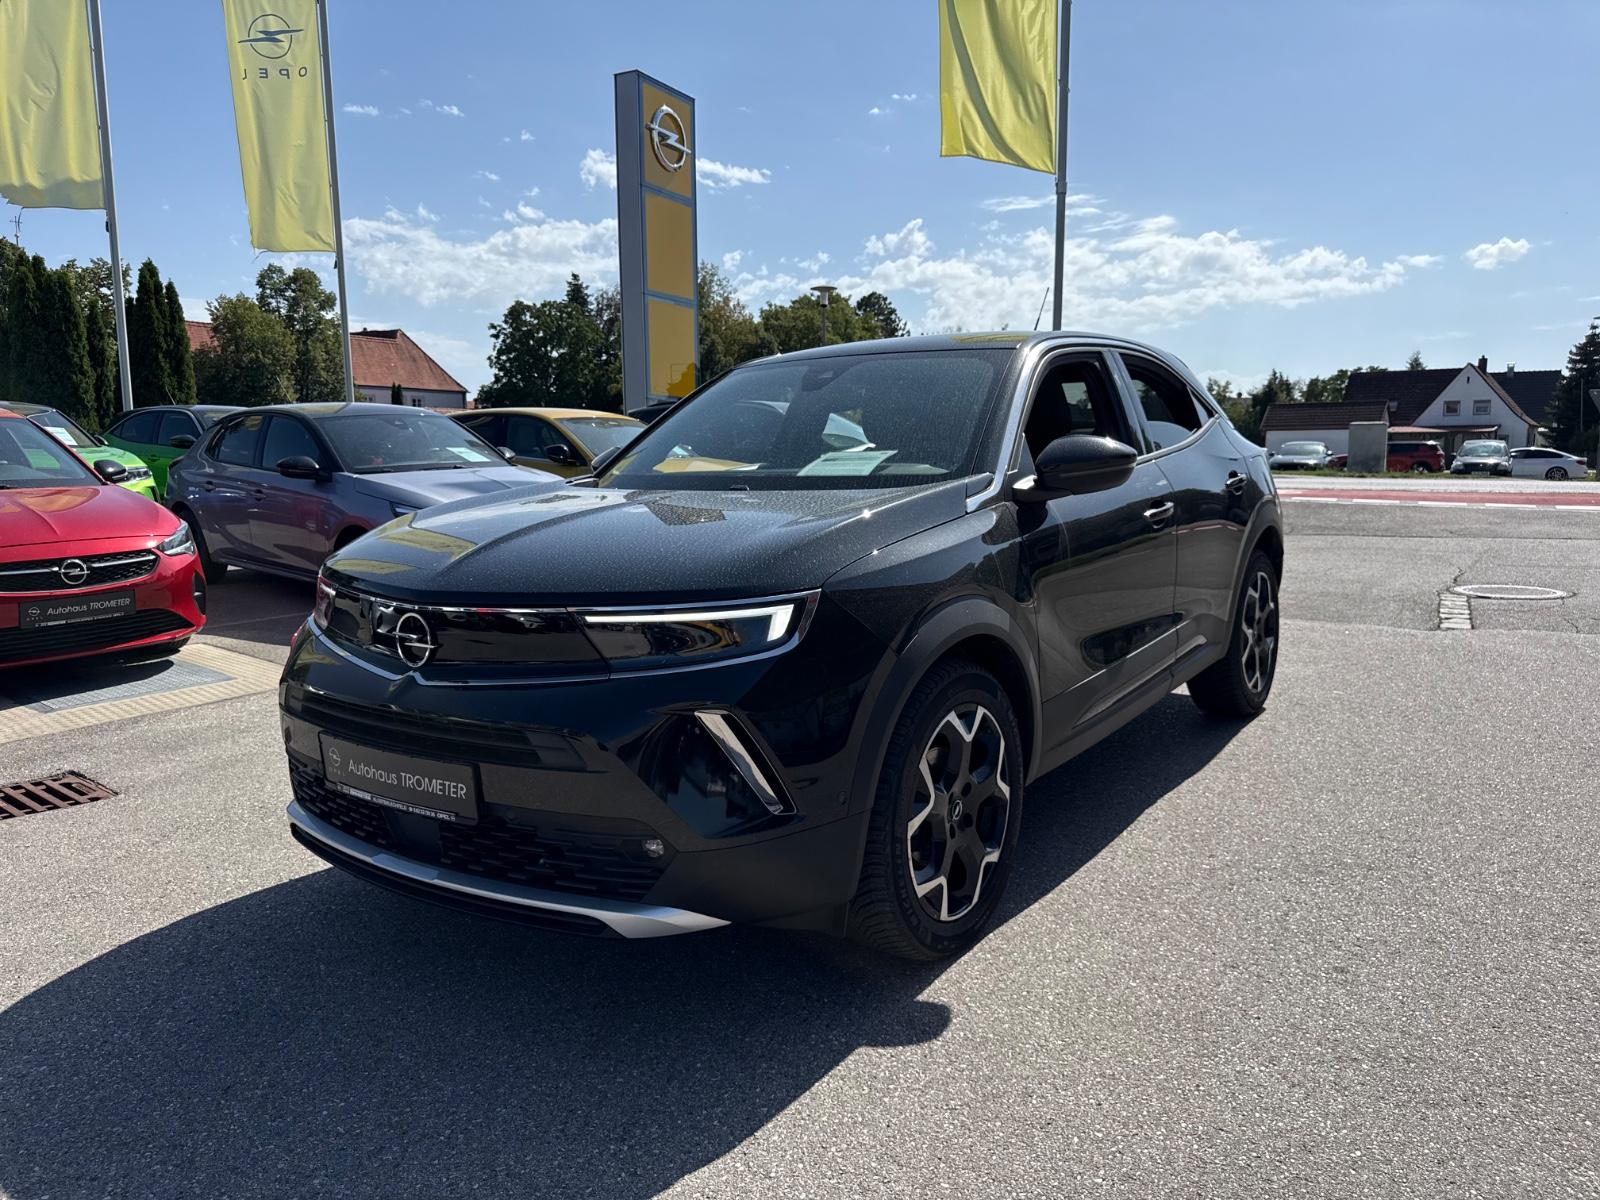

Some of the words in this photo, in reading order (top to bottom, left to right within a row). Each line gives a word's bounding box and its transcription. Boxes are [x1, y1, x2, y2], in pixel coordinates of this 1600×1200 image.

[47, 605, 88, 616] Autohaus
[89, 597, 131, 610] TROMETER
[348, 759, 398, 785] Autohaus
[400, 772, 467, 799] TROMETER
